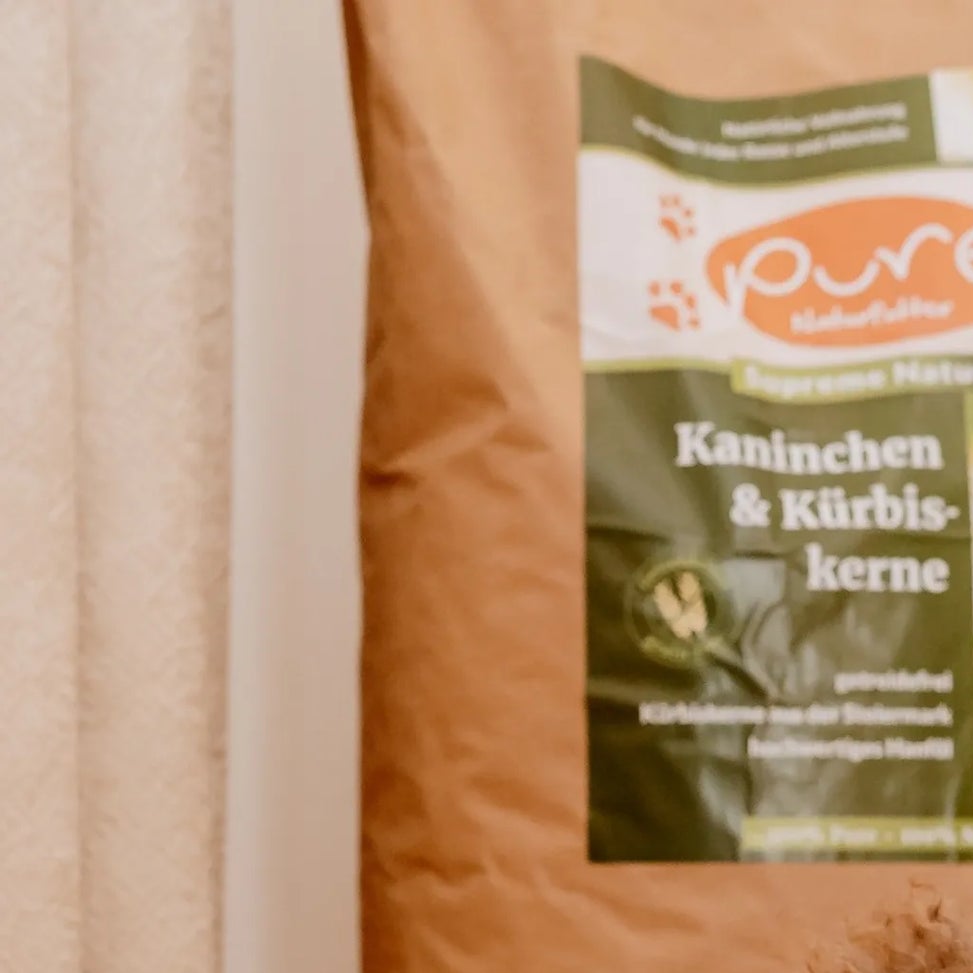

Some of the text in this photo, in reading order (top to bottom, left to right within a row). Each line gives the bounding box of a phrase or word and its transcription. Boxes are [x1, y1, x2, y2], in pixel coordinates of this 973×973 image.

[675, 421, 944, 476] Kaninchen
[729, 483, 961, 531] & Kürbis-
[804, 543, 950, 594] kerne
